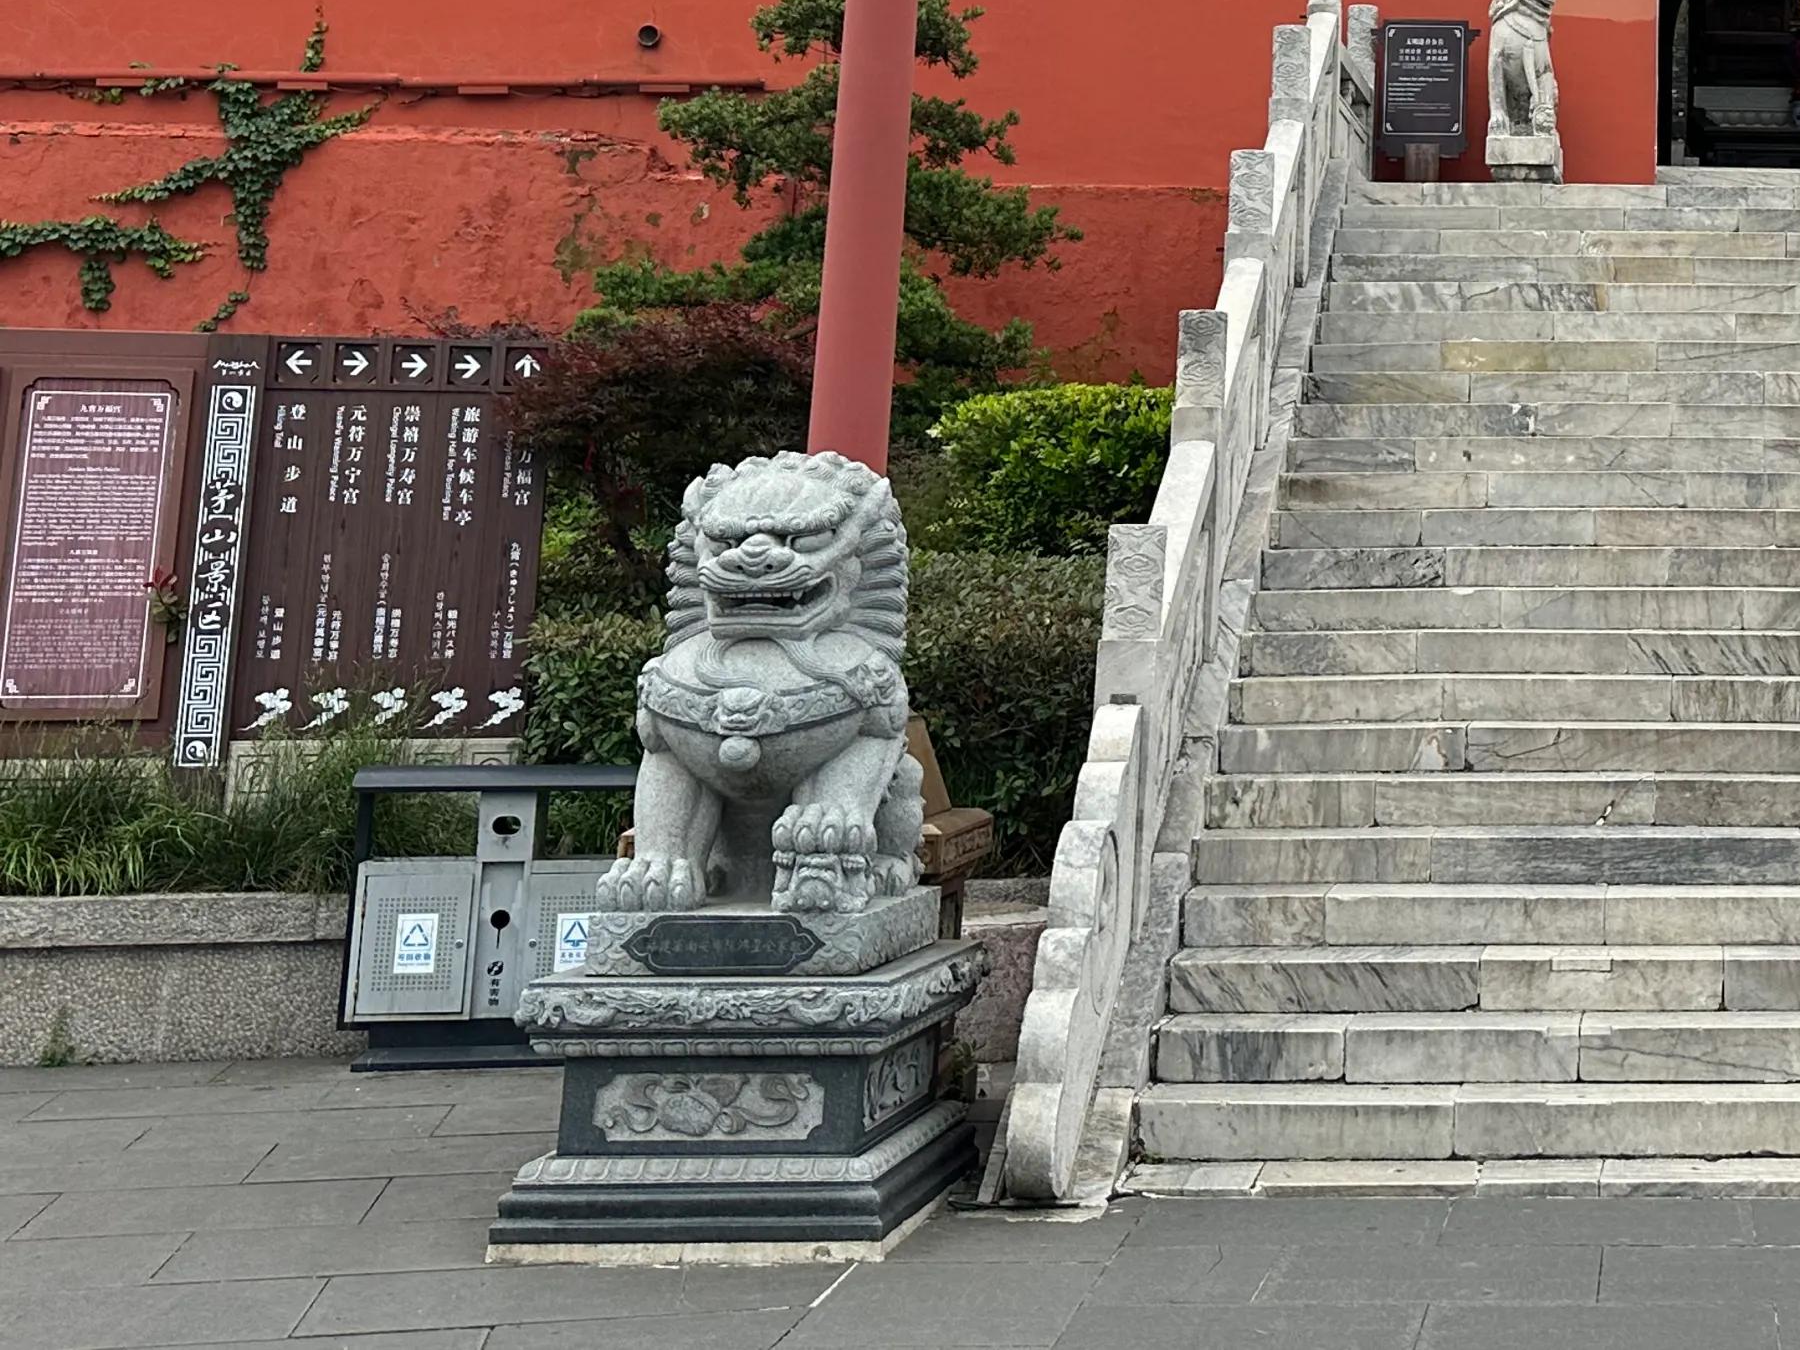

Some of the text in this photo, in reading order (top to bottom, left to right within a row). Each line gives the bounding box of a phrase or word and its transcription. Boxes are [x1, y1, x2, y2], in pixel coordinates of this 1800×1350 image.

[280, 404, 306, 513] 登山步道
[342, 405, 367, 505] 元符万宁宫
[397, 405, 421, 505] 崇禧万寿宫
[454, 407, 481, 526] 旅游车候车亭
